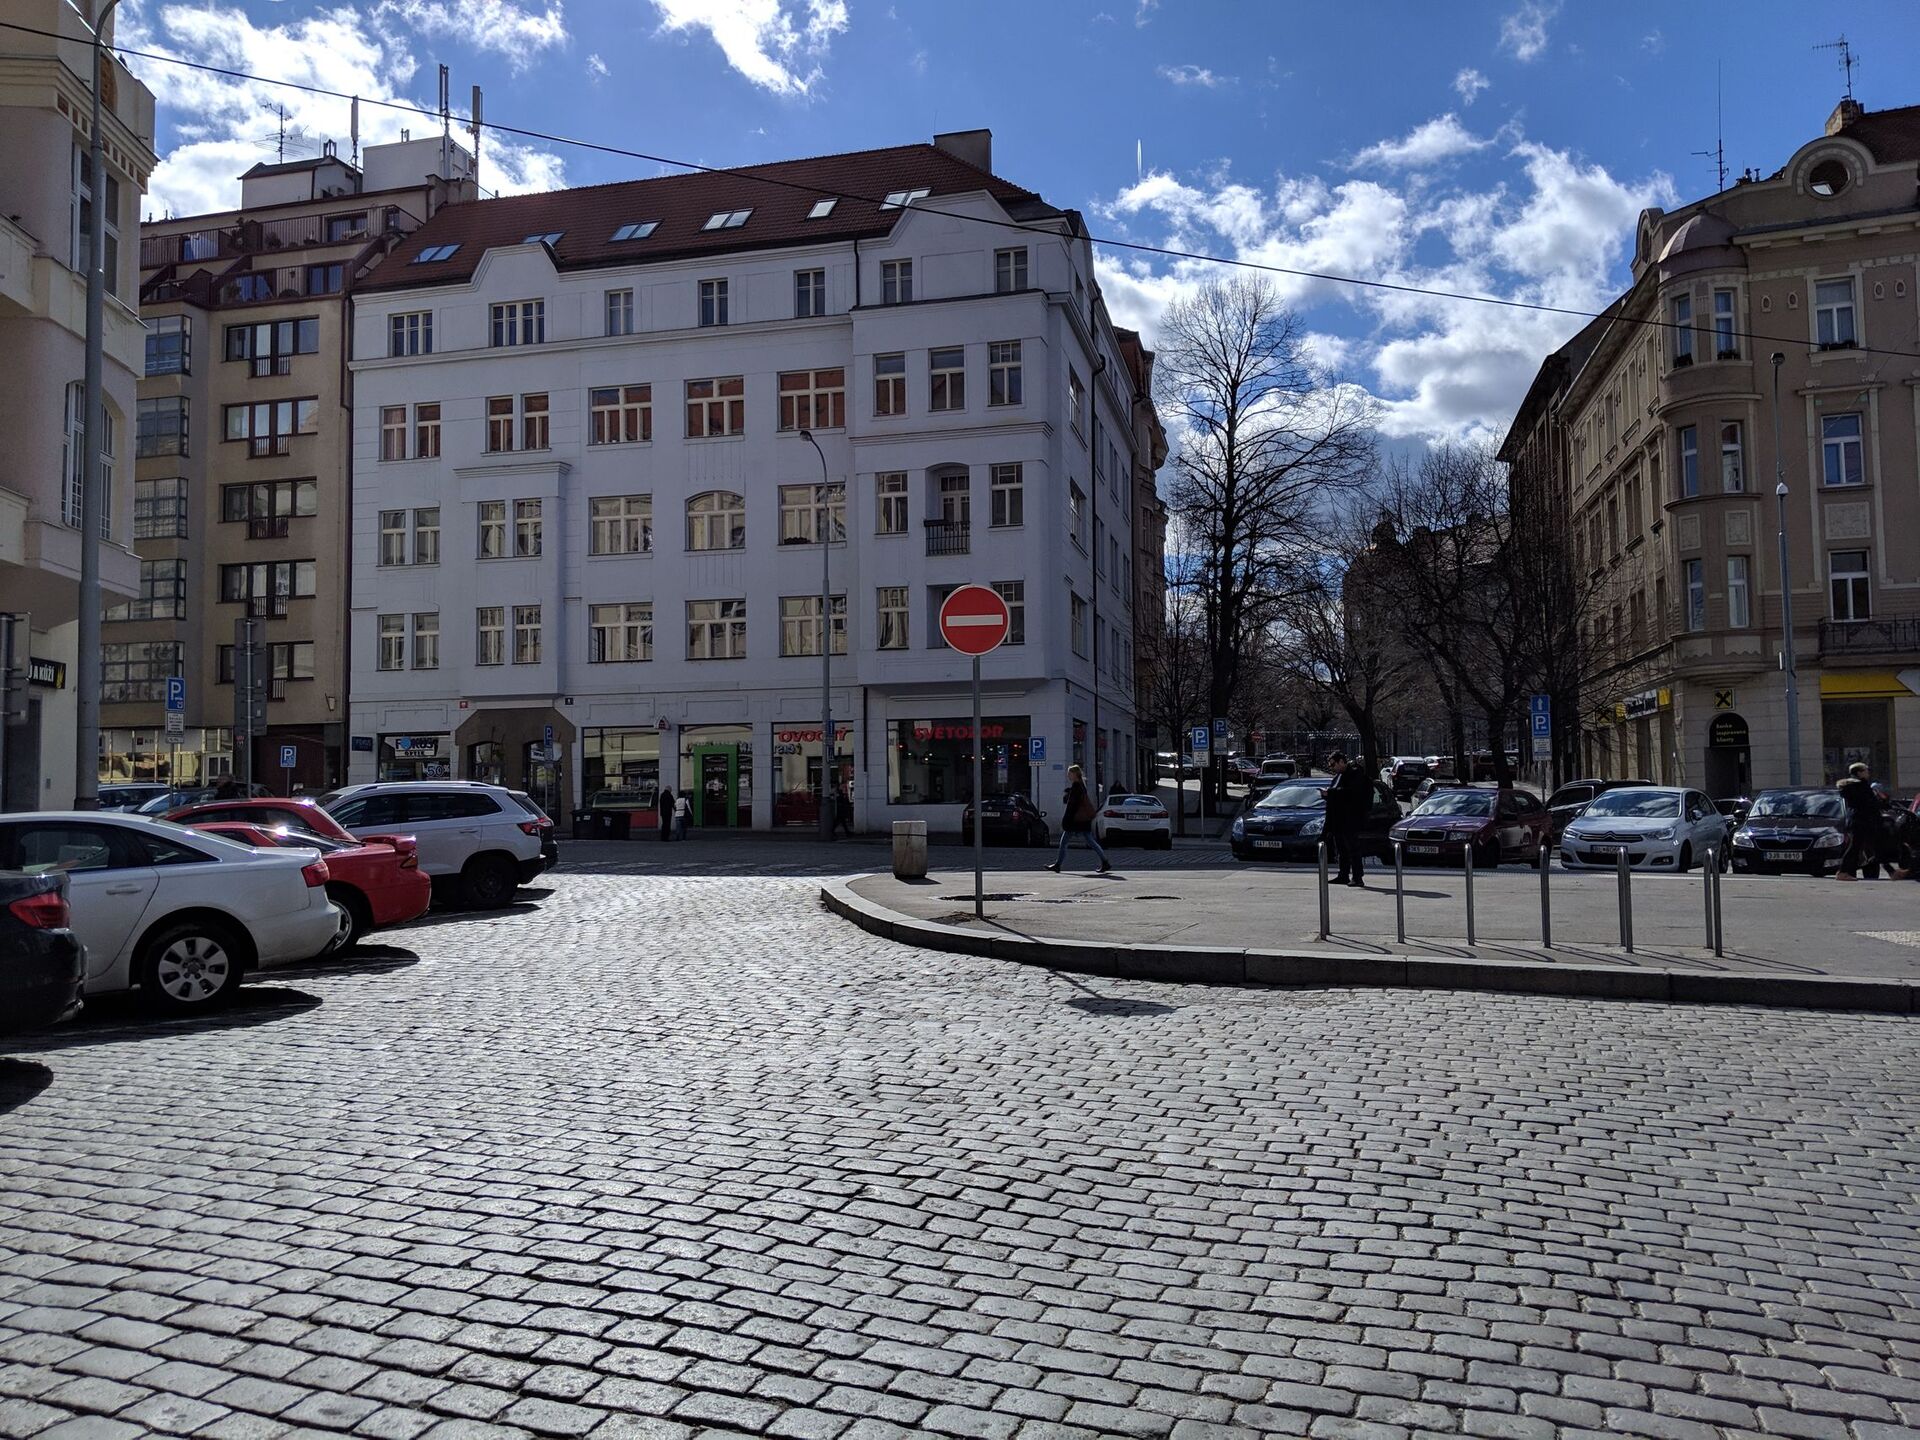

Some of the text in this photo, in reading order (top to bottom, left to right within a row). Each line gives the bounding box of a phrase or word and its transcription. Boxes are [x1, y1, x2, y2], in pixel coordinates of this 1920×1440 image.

[170, 681, 182, 701] P
[1215, 720, 1225, 732] P
[1535, 715, 1547, 730] P
[1195, 729, 1206, 744] P
[1032, 739, 1042, 754] P
[283, 748, 293, 761] P
